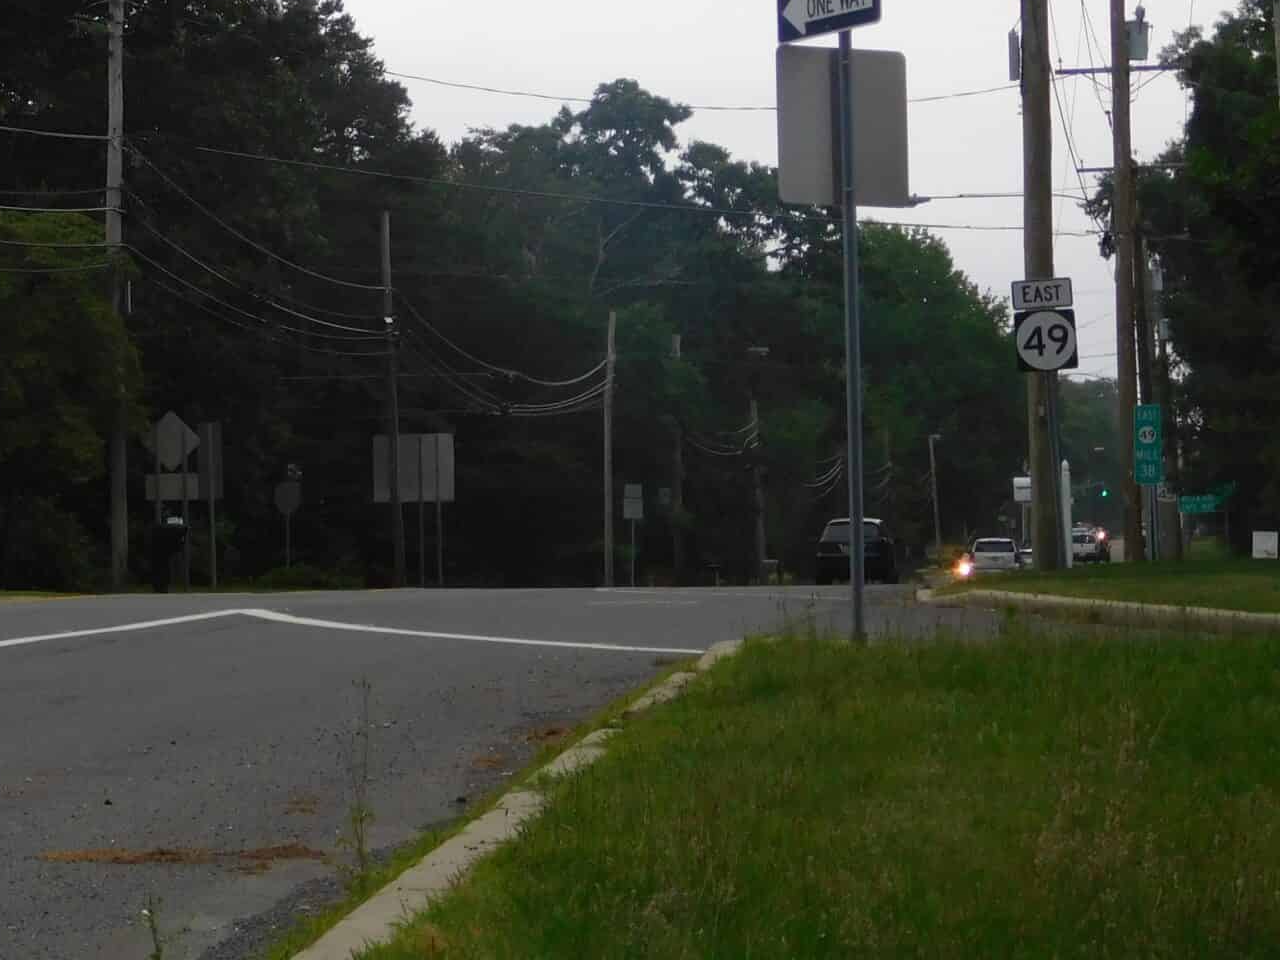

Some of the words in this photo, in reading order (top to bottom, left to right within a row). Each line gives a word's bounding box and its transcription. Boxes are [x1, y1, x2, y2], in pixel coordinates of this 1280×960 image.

[1022, 284, 1062, 303] EAST
[1023, 324, 1069, 356] 49
[1137, 409, 1158, 420] EAST
